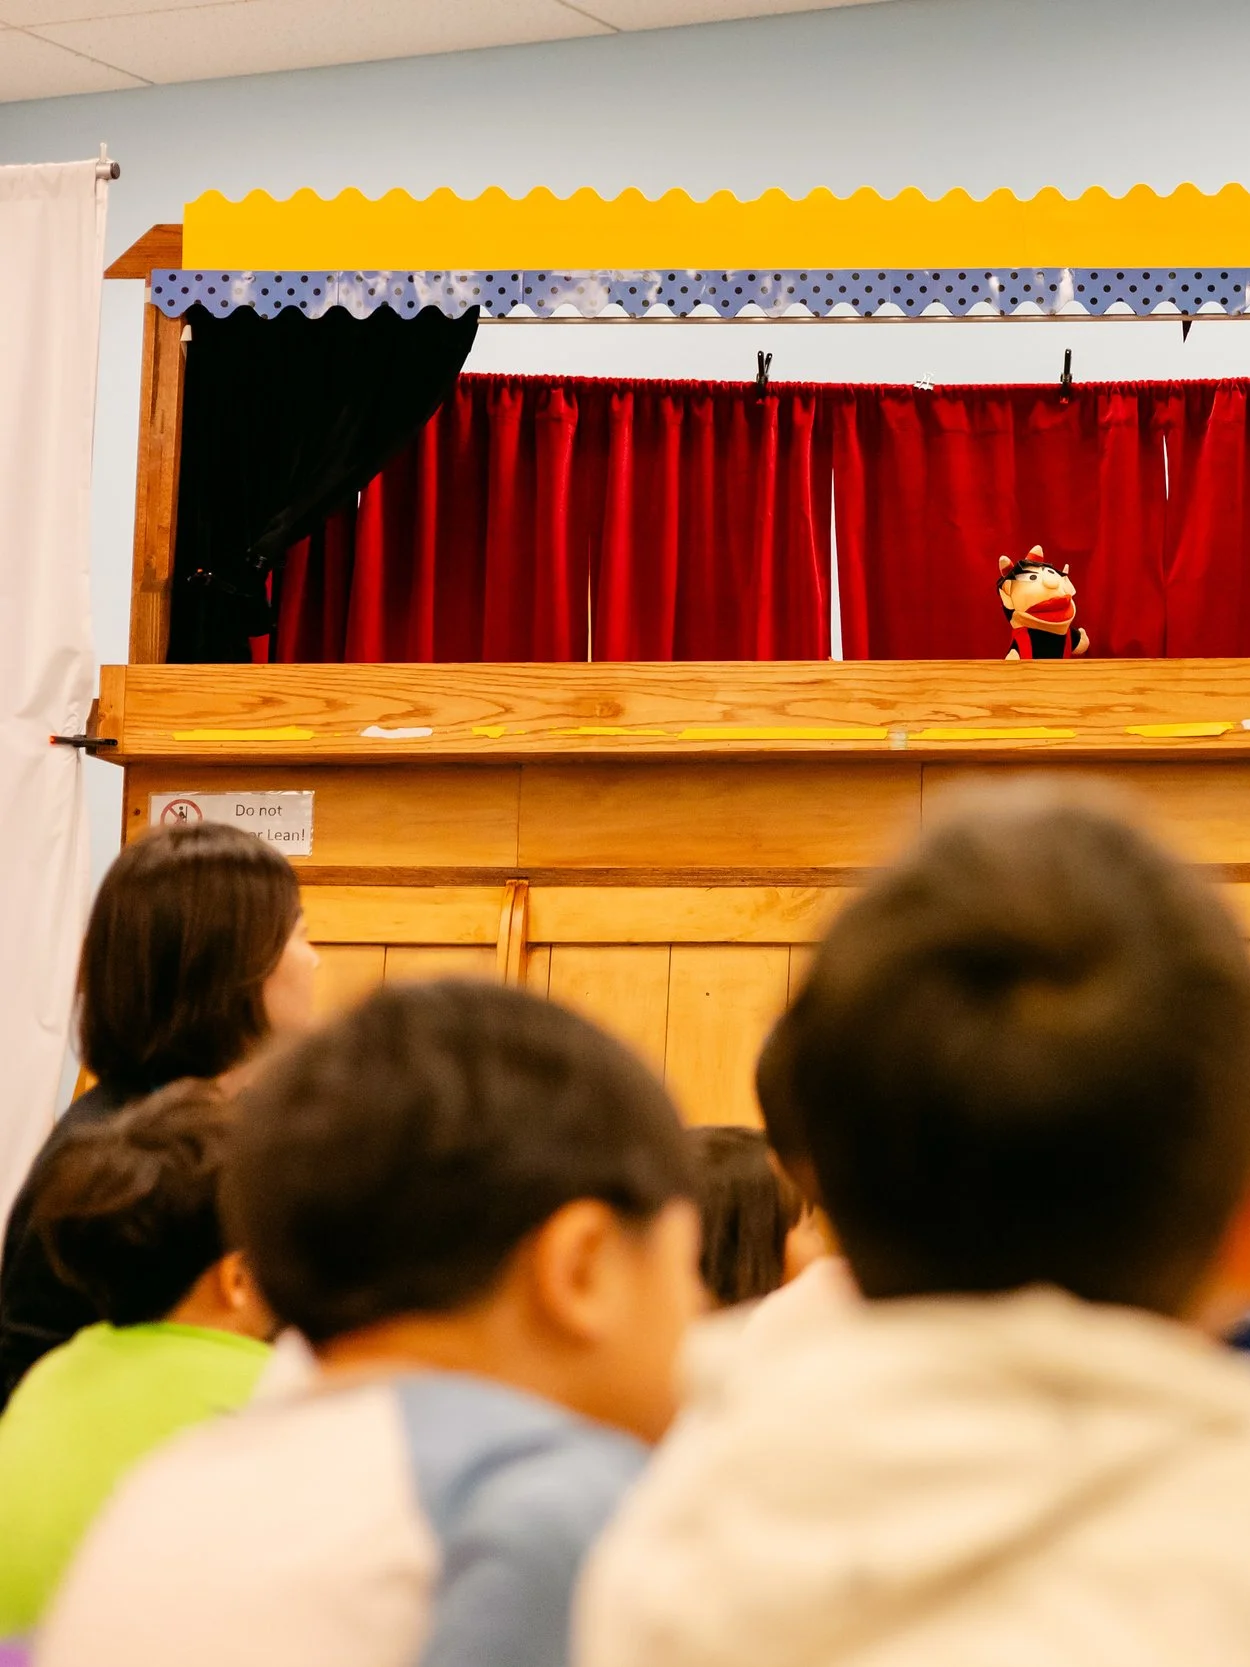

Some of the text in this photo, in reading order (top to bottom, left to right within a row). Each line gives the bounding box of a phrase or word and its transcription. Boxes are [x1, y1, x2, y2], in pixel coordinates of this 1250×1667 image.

[235, 804, 283, 817] Do not
[267, 829, 305, 841] Lean!
